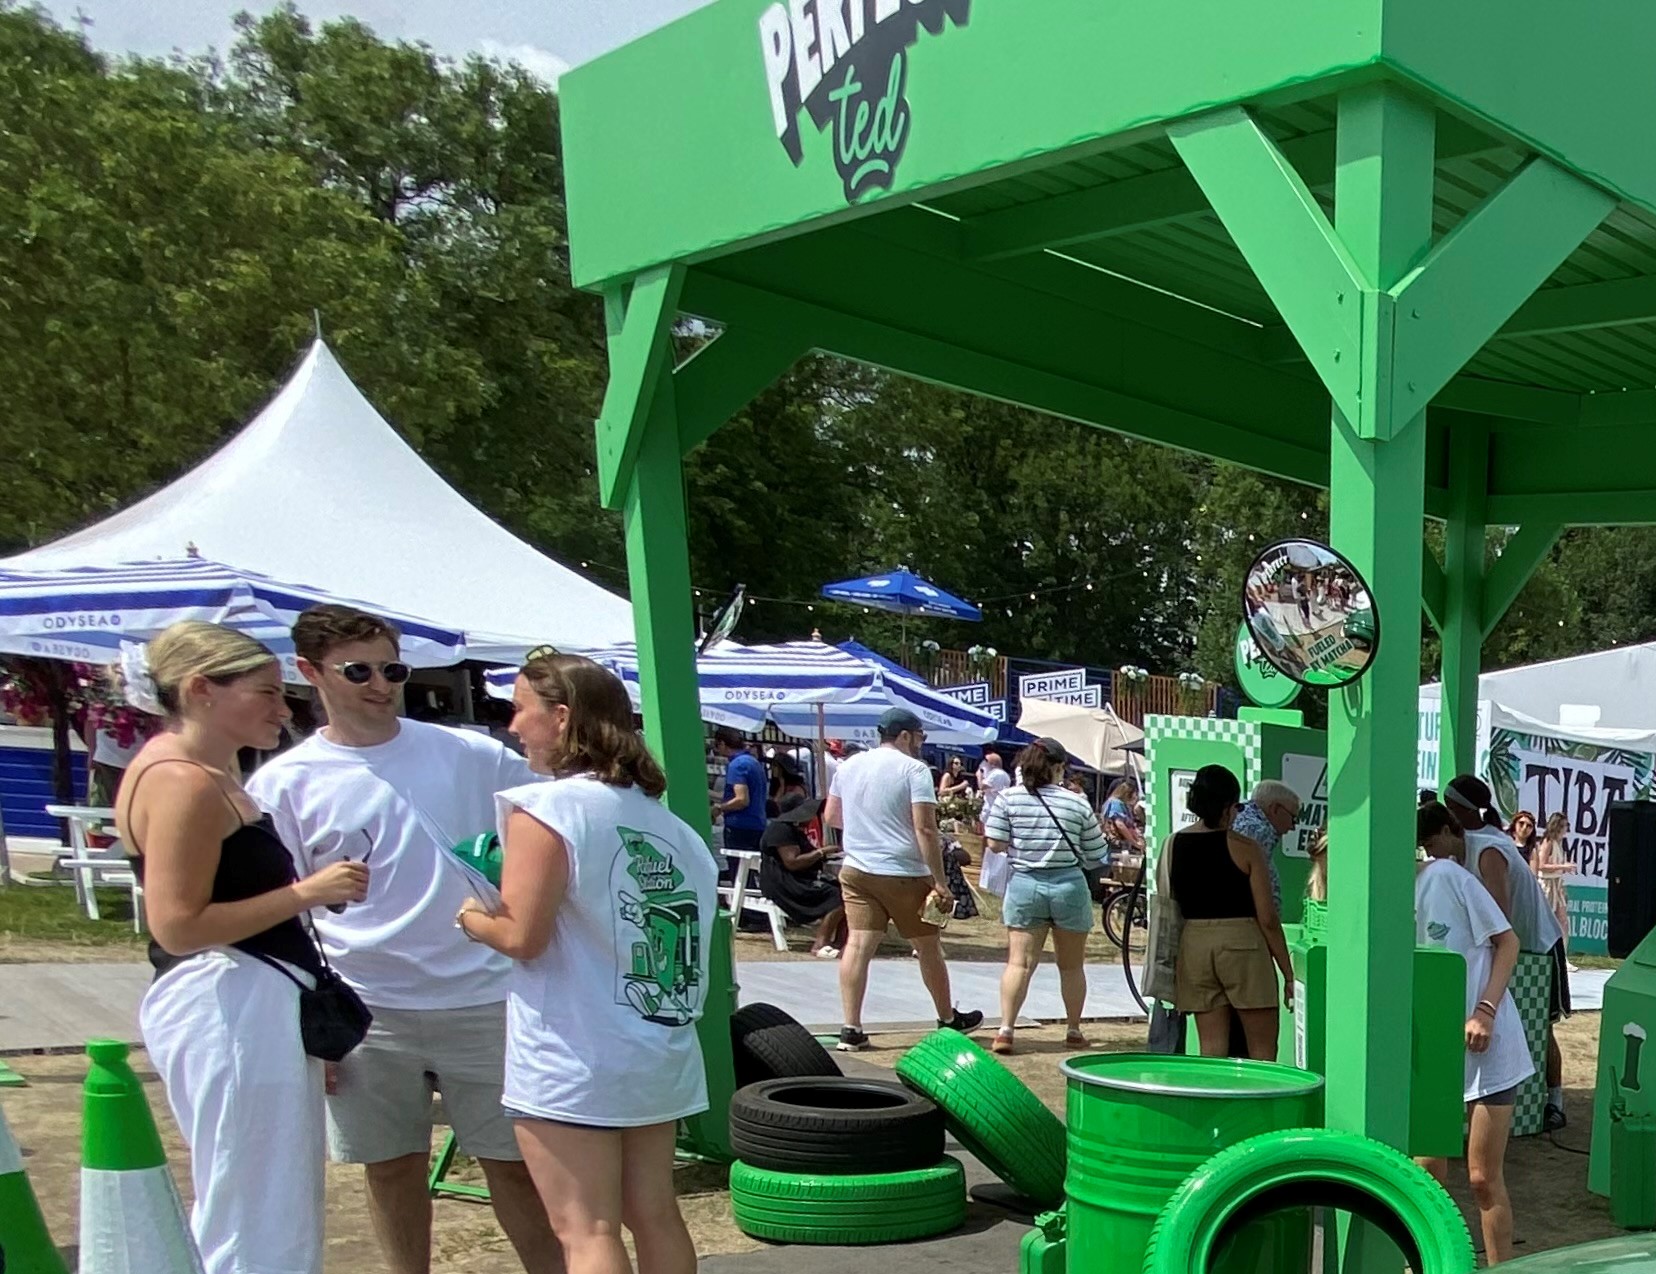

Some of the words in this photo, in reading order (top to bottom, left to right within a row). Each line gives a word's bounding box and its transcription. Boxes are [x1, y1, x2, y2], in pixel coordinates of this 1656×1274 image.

[829, 53, 905, 165] ted
[43, 615, 107, 629] ODYSEA
[1307, 633, 1336, 659] FUELED
[1321, 639, 1354, 666] MATCHA
[724, 690, 776, 701] ODYSEA
[1027, 677, 1078, 694] PRIME
[1054, 692, 1094, 706] TIME
[1524, 763, 1628, 837] TIBA
